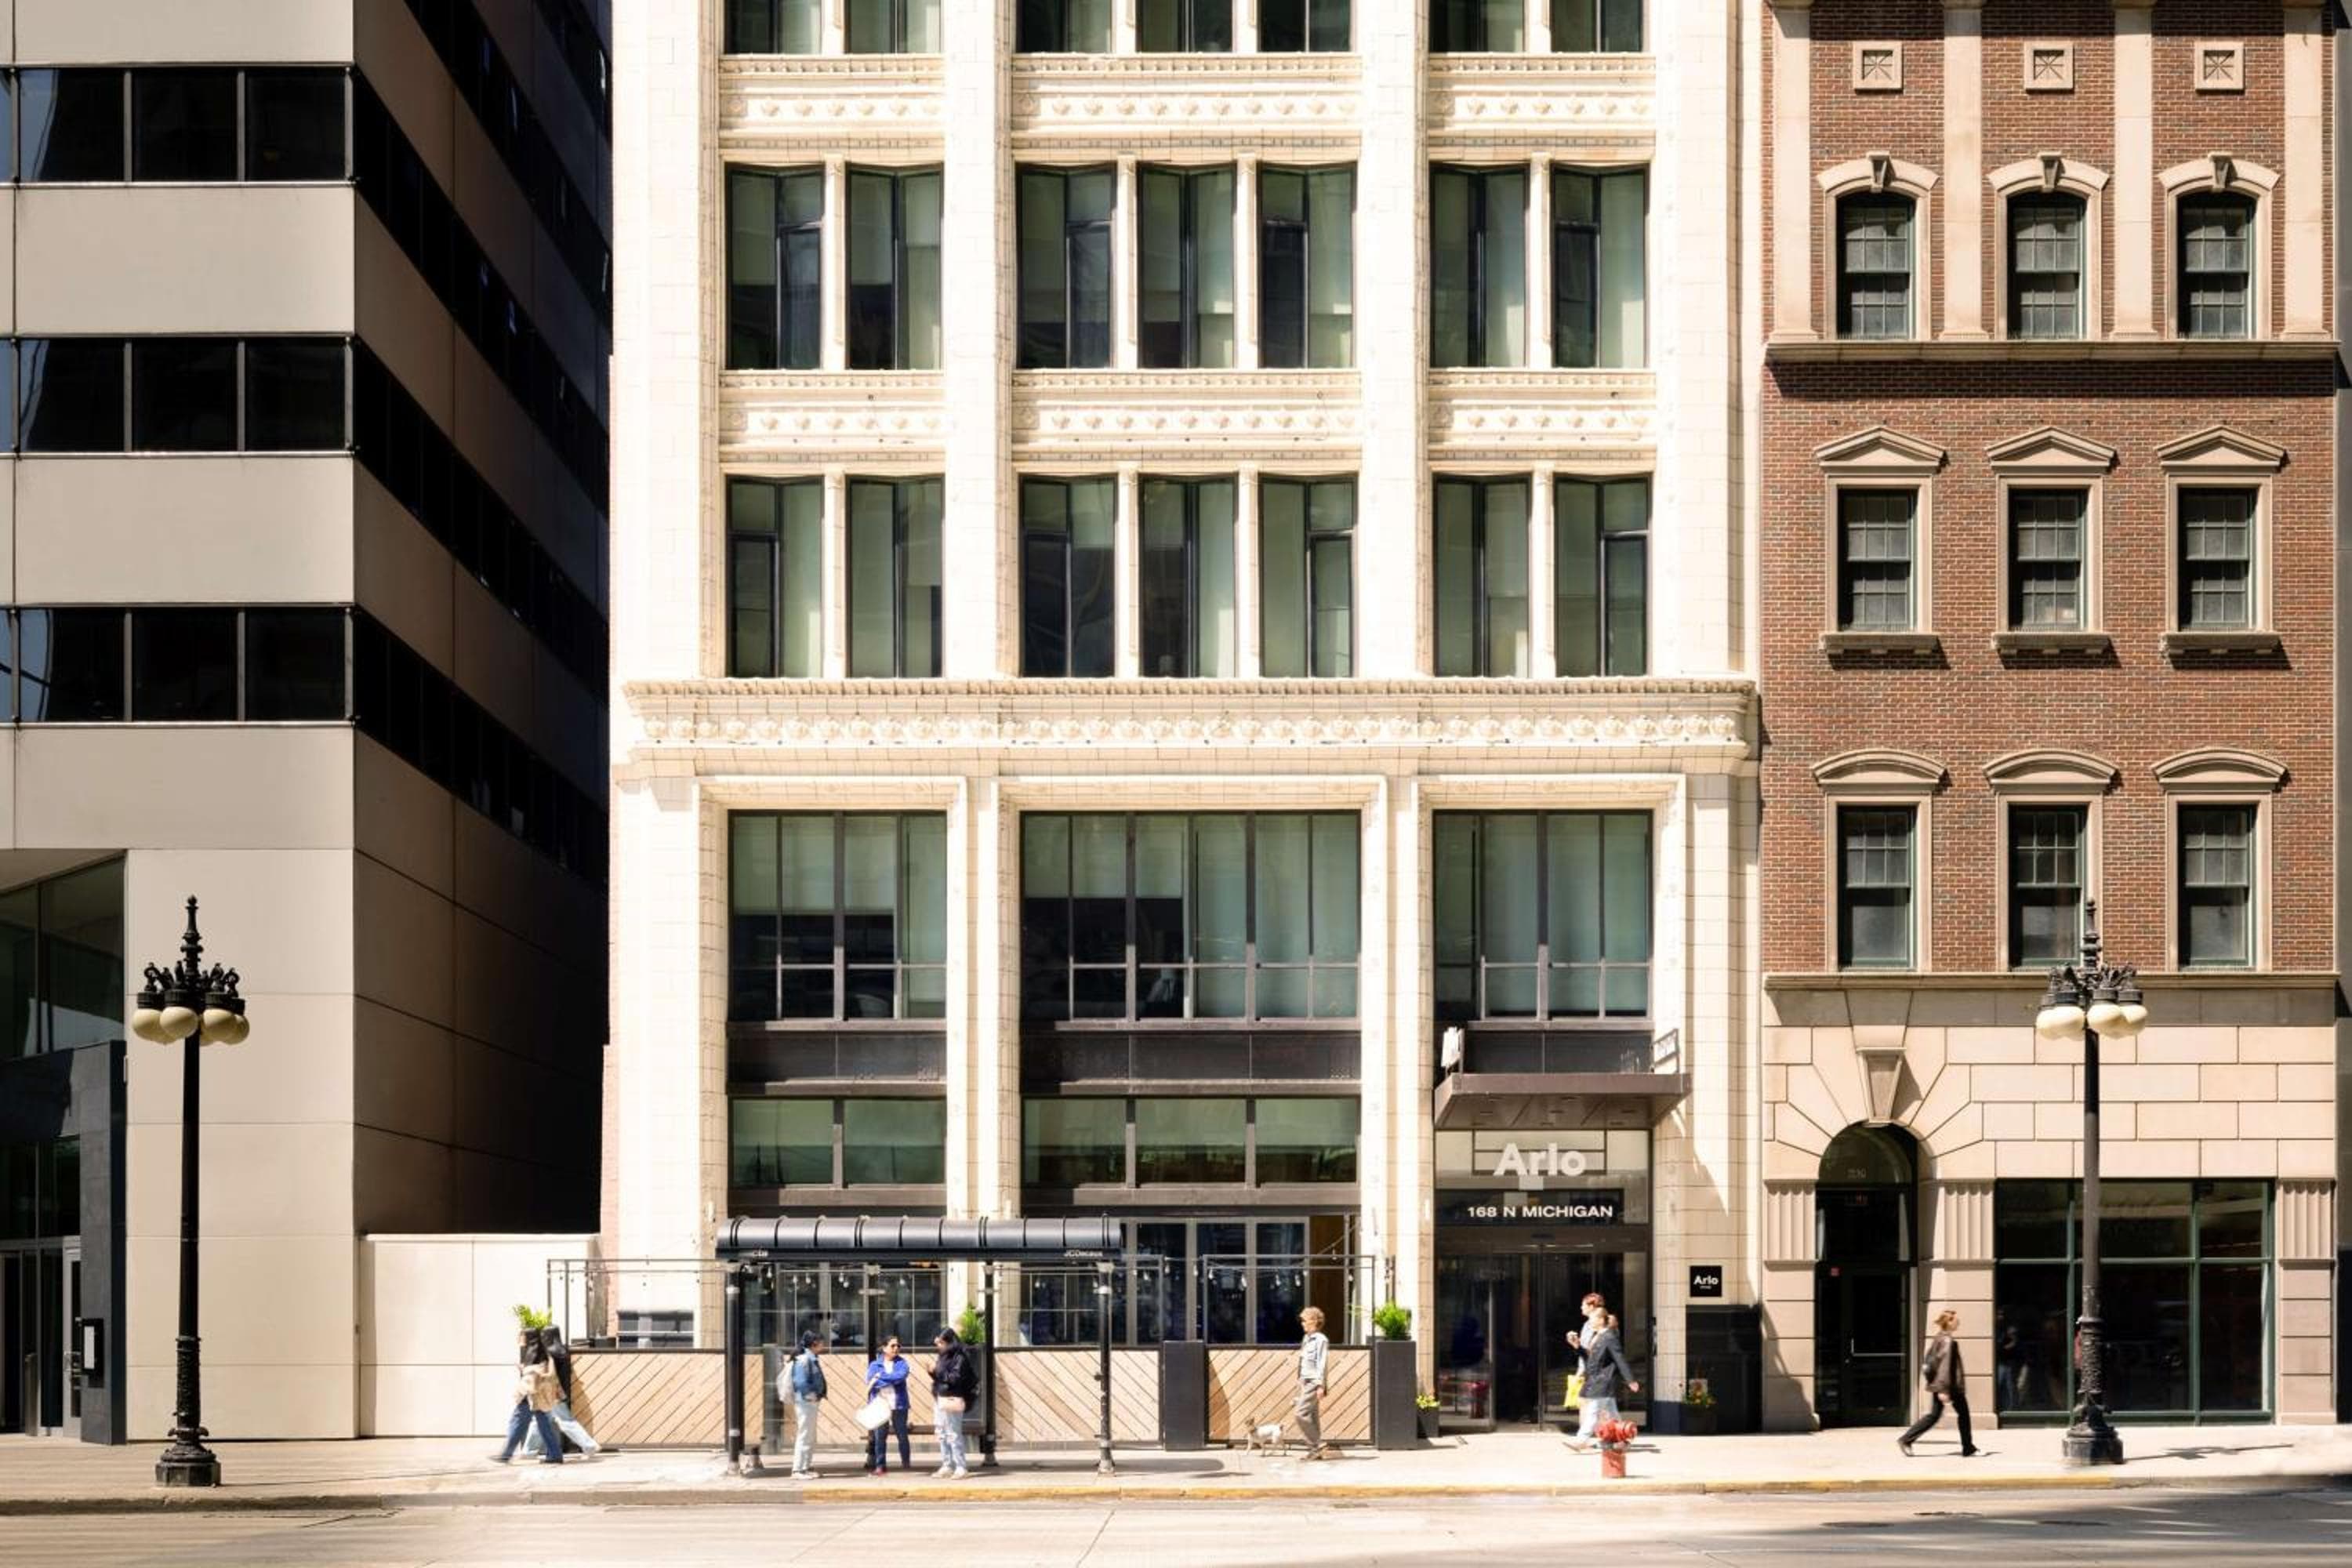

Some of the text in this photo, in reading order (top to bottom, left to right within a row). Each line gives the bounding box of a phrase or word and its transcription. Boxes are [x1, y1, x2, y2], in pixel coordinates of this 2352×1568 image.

[1493, 1142, 1586, 1177] Arlo
[1468, 1205, 1613, 1218] 168 N MICHIGAN
[1693, 1275, 1719, 1285] Arlo
